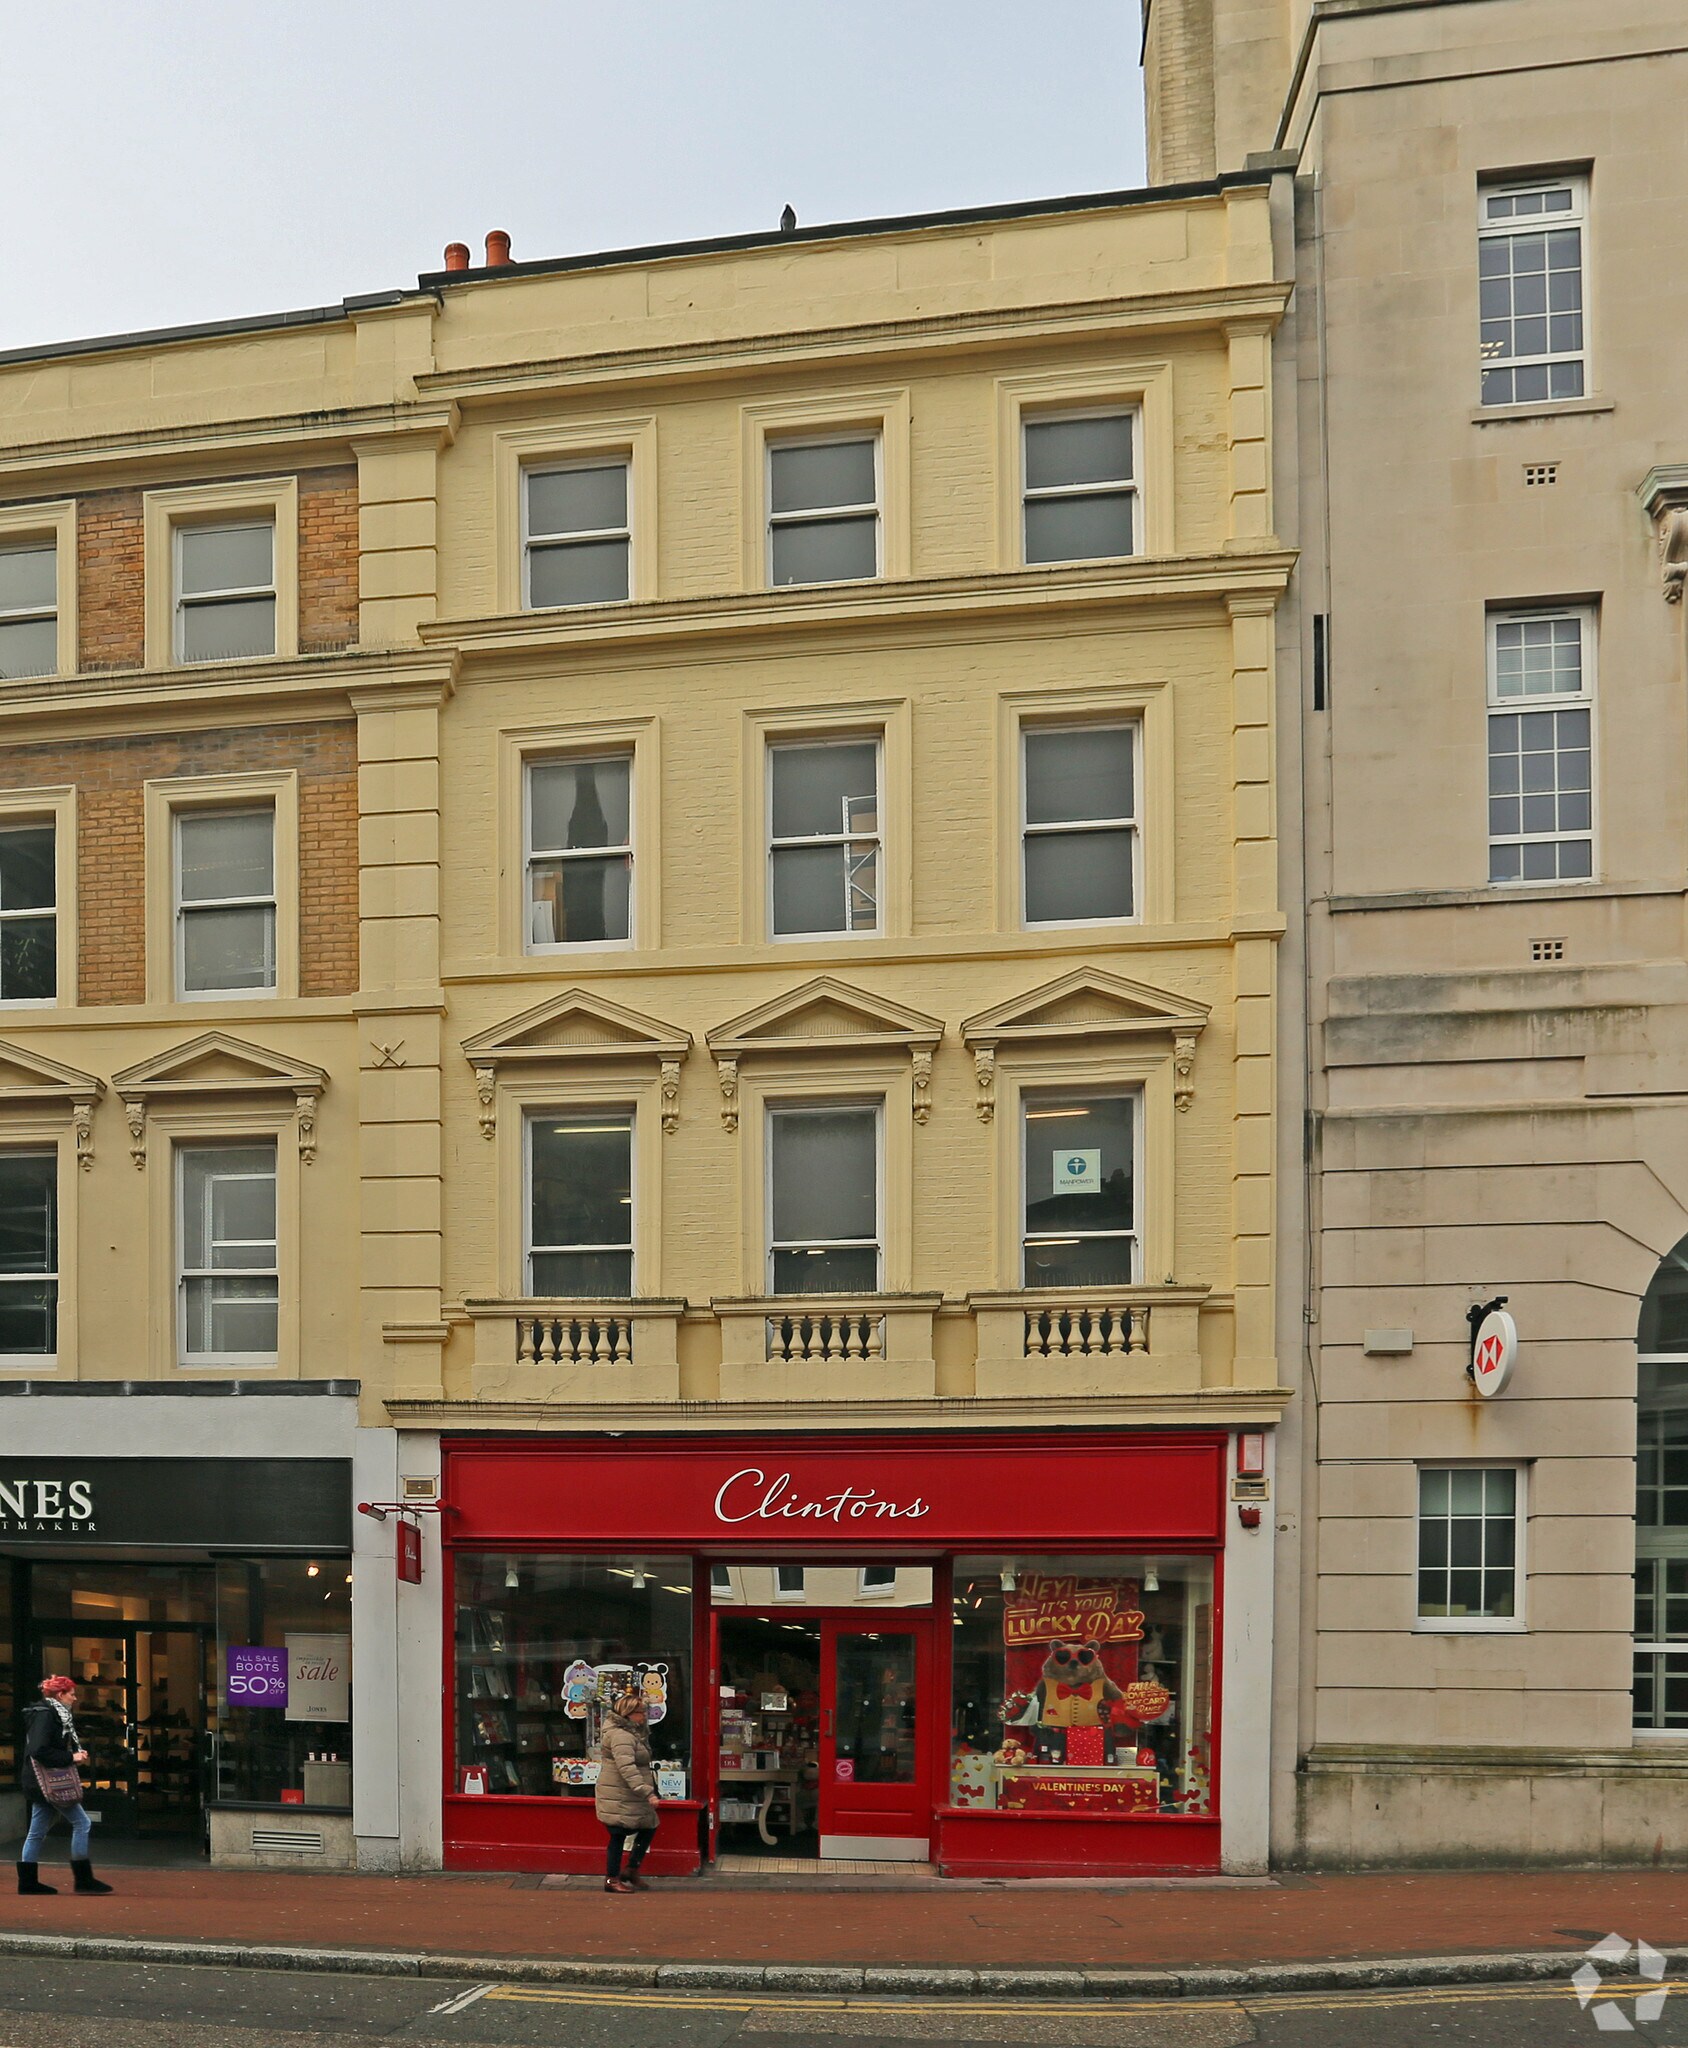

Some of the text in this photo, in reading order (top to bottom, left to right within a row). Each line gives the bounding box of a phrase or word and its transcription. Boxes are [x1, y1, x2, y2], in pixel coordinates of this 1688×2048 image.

[0, 1480, 92, 1520] NES
[714, 1468, 930, 1523] Clintons
[2, 1521, 97, 1531] TMAKER
[1019, 1574, 1074, 1600] HEY!
[1040, 1596, 1113, 1615] IT'S YOUR
[1008, 1611, 1139, 1640] LUCKY DAY
[236, 1663, 280, 1672] BOOTS
[255, 1655, 279, 1663] SALE
[296, 1657, 339, 1681] sale
[229, 1675, 286, 1694] 50%
[1143, 1697, 1166, 1705] CARD
[1032, 1782, 1125, 1792] VALENTINE'S DAY
